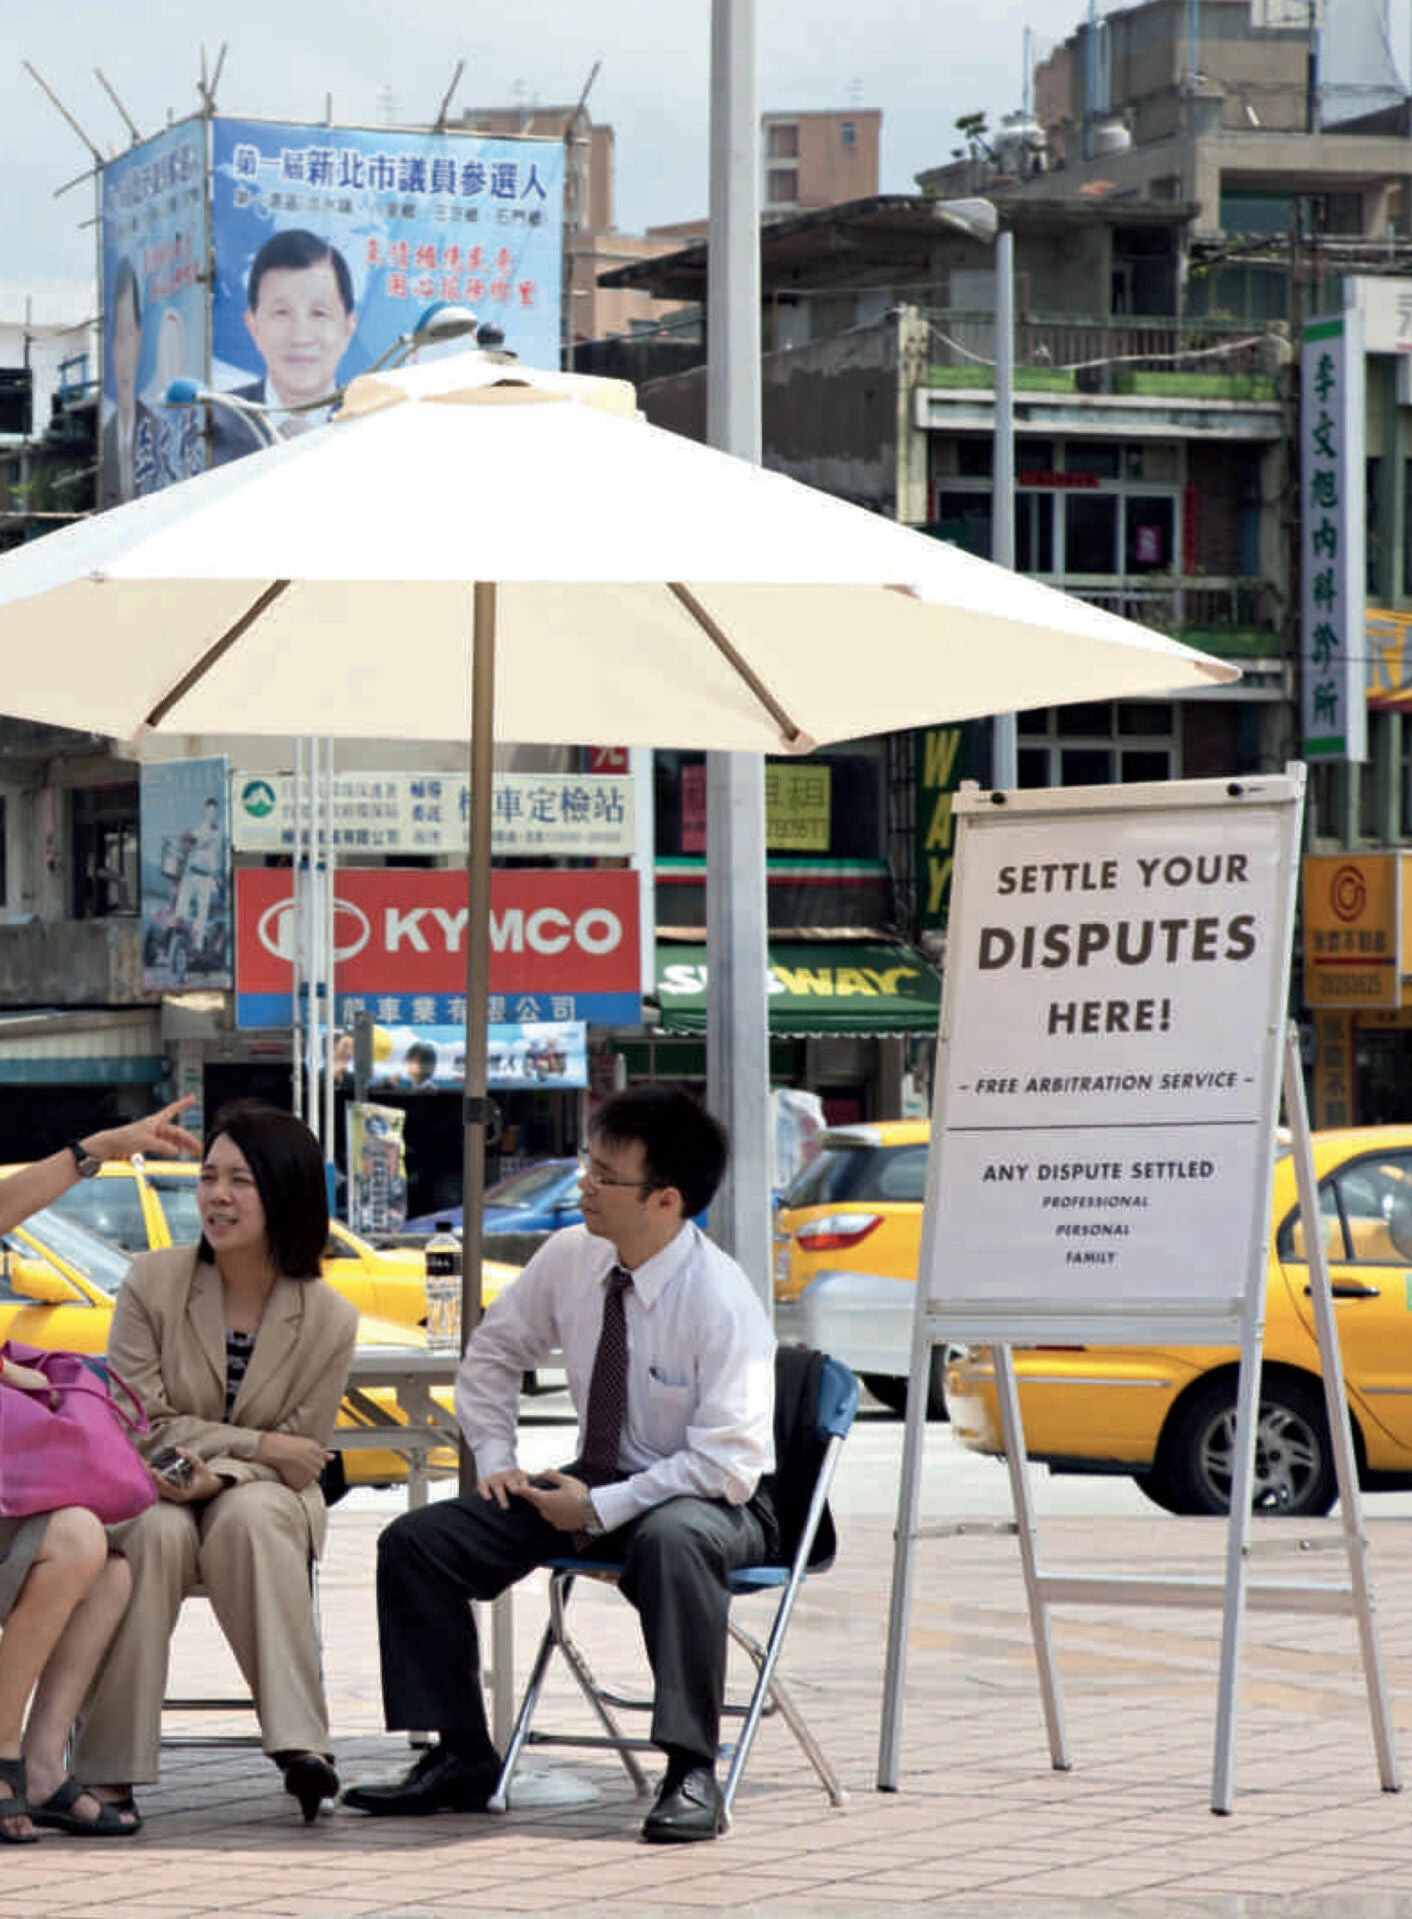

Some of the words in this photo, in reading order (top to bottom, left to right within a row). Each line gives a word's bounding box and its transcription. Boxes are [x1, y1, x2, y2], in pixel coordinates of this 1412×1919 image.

[997, 860, 1118, 895] SETTLE
[1137, 853, 1249, 887] YOUR
[384, 907, 623, 955] KYMCO
[977, 915, 1256, 970] DISPUTES
[1048, 998, 1172, 1035] HERE!
[975, 1077, 1018, 1094] FREE
[1025, 1073, 1152, 1093] ARBITRATION
[1160, 1071, 1237, 1091] SERVICE
[983, 1164, 1030, 1182] ANY
[1037, 1162, 1123, 1181] DISPUTE
[1131, 1160, 1215, 1179] SETTLED
[1042, 1195, 1149, 1208] PROFESSIONAL
[1056, 1224, 1130, 1237] PERSONAL
[1066, 1251, 1117, 1264] FAMILY
